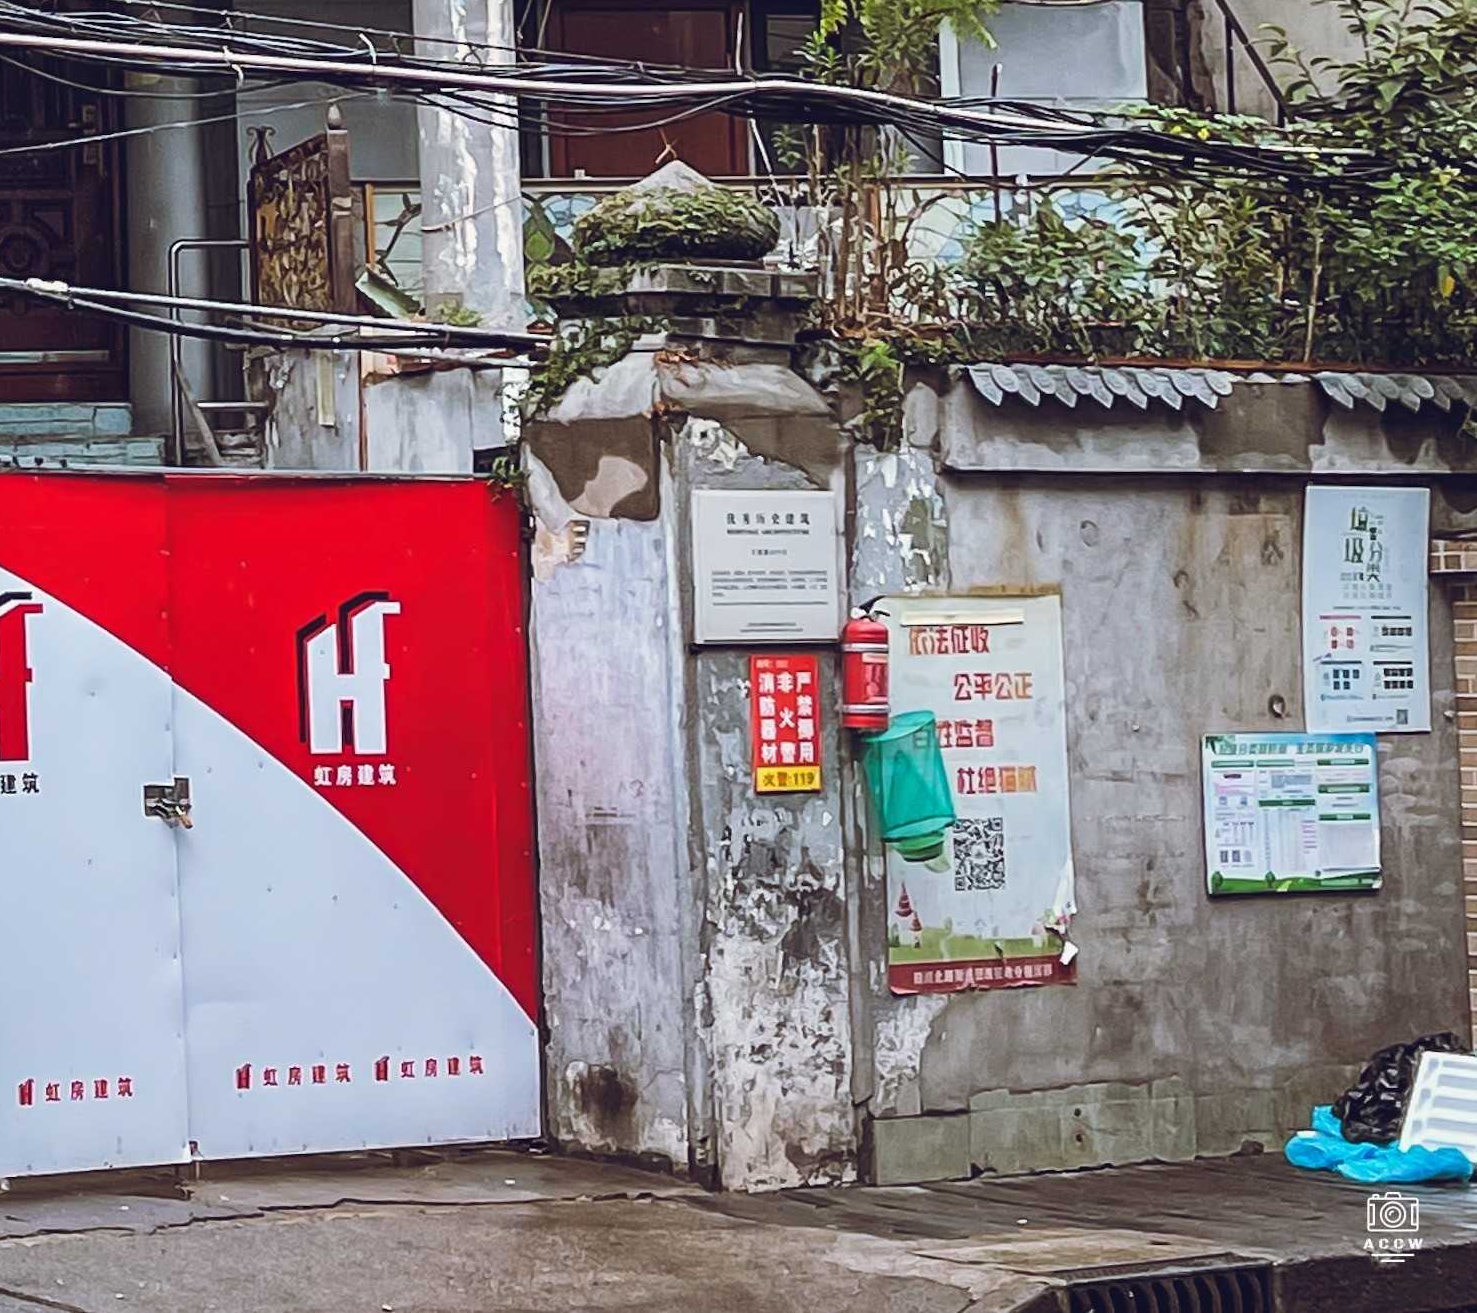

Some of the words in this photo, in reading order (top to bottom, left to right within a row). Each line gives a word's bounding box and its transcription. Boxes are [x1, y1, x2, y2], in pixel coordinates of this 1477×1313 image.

[954, 672, 1034, 702] 公平公正
[314, 764, 397, 786] 虹房建筑
[263, 1062, 352, 1087] 虹房建筑
[398, 1051, 484, 1078] 虹房建筑
[45, 1077, 134, 1102] 虹房建筑
